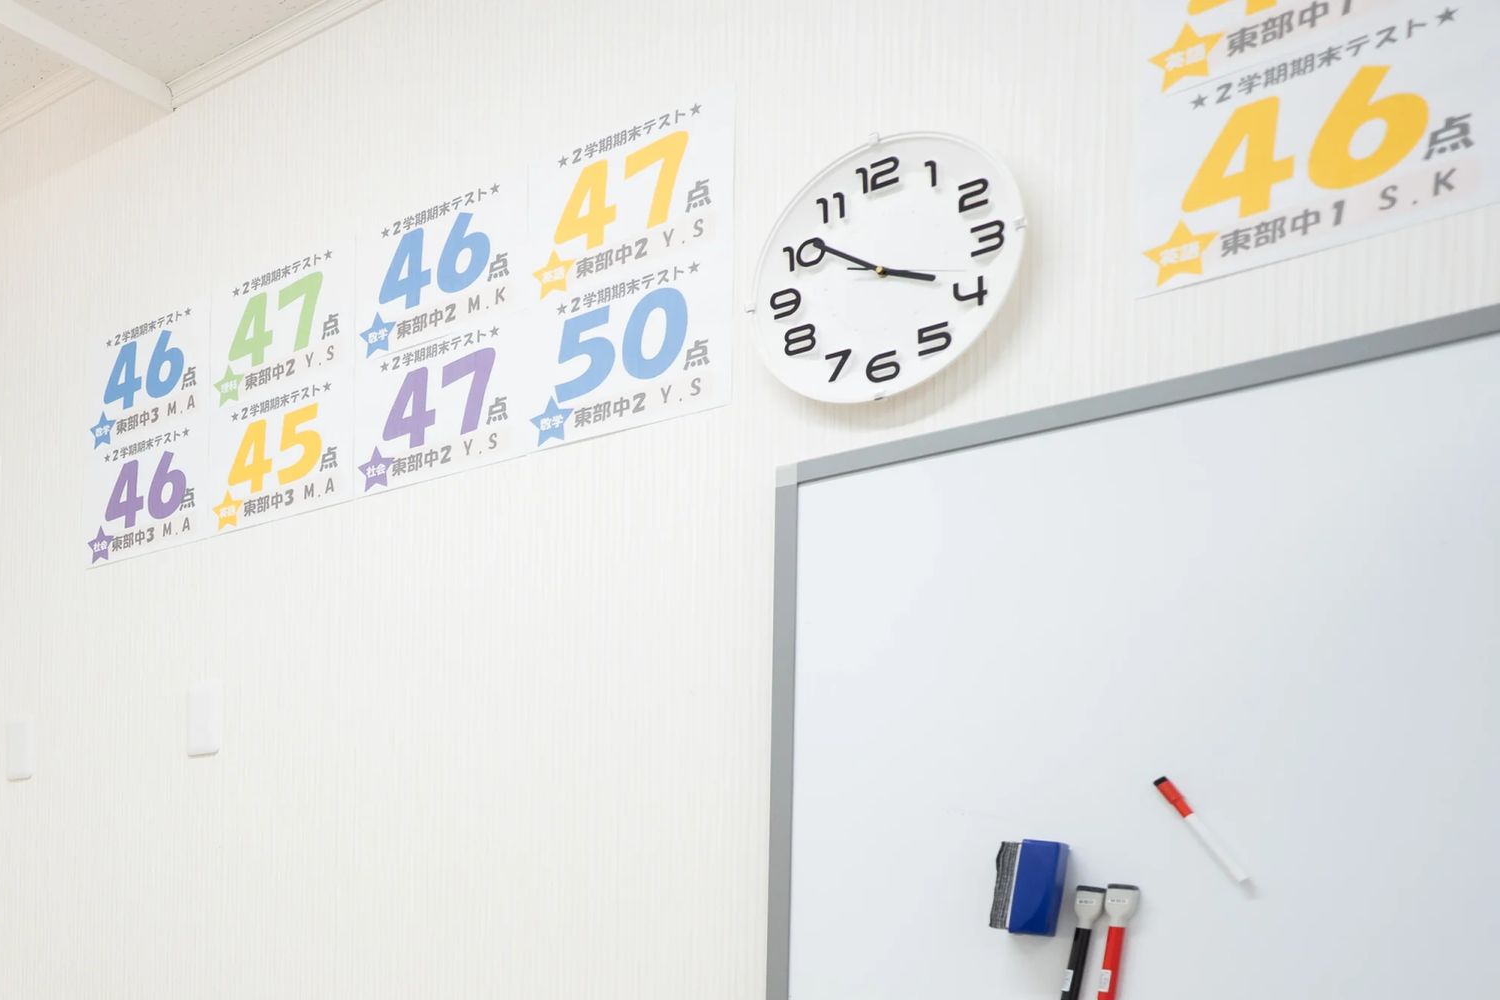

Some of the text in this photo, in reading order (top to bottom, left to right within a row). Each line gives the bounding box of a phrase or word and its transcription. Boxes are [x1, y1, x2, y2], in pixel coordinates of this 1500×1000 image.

[855, 156, 899, 194] 12
[924, 160, 937, 187] 1
[816, 192, 845, 224] 11
[958, 178, 989, 213] 2
[970, 219, 1005, 257] 3
[1220, 200, 1345, 258] 東部中1
[576, 237, 648, 280] 東部中2
[782, 237, 826, 272] 10
[770, 288, 801, 320] 9
[953, 275, 988, 306] 4
[396, 303, 457, 340] 東部中2
[784, 323, 816, 356] 8
[918, 321, 952, 357] 5
[245, 359, 295, 391] 東部中2
[825, 349, 852, 383] 7
[866, 350, 900, 383] 6
[116, 407, 159, 435] 東部中3
[574, 392, 646, 428] 東部中2
[391, 445, 452, 477] 東部中2
[244, 488, 294, 517] 東部中3
[111, 527, 155, 552] 東部中3
